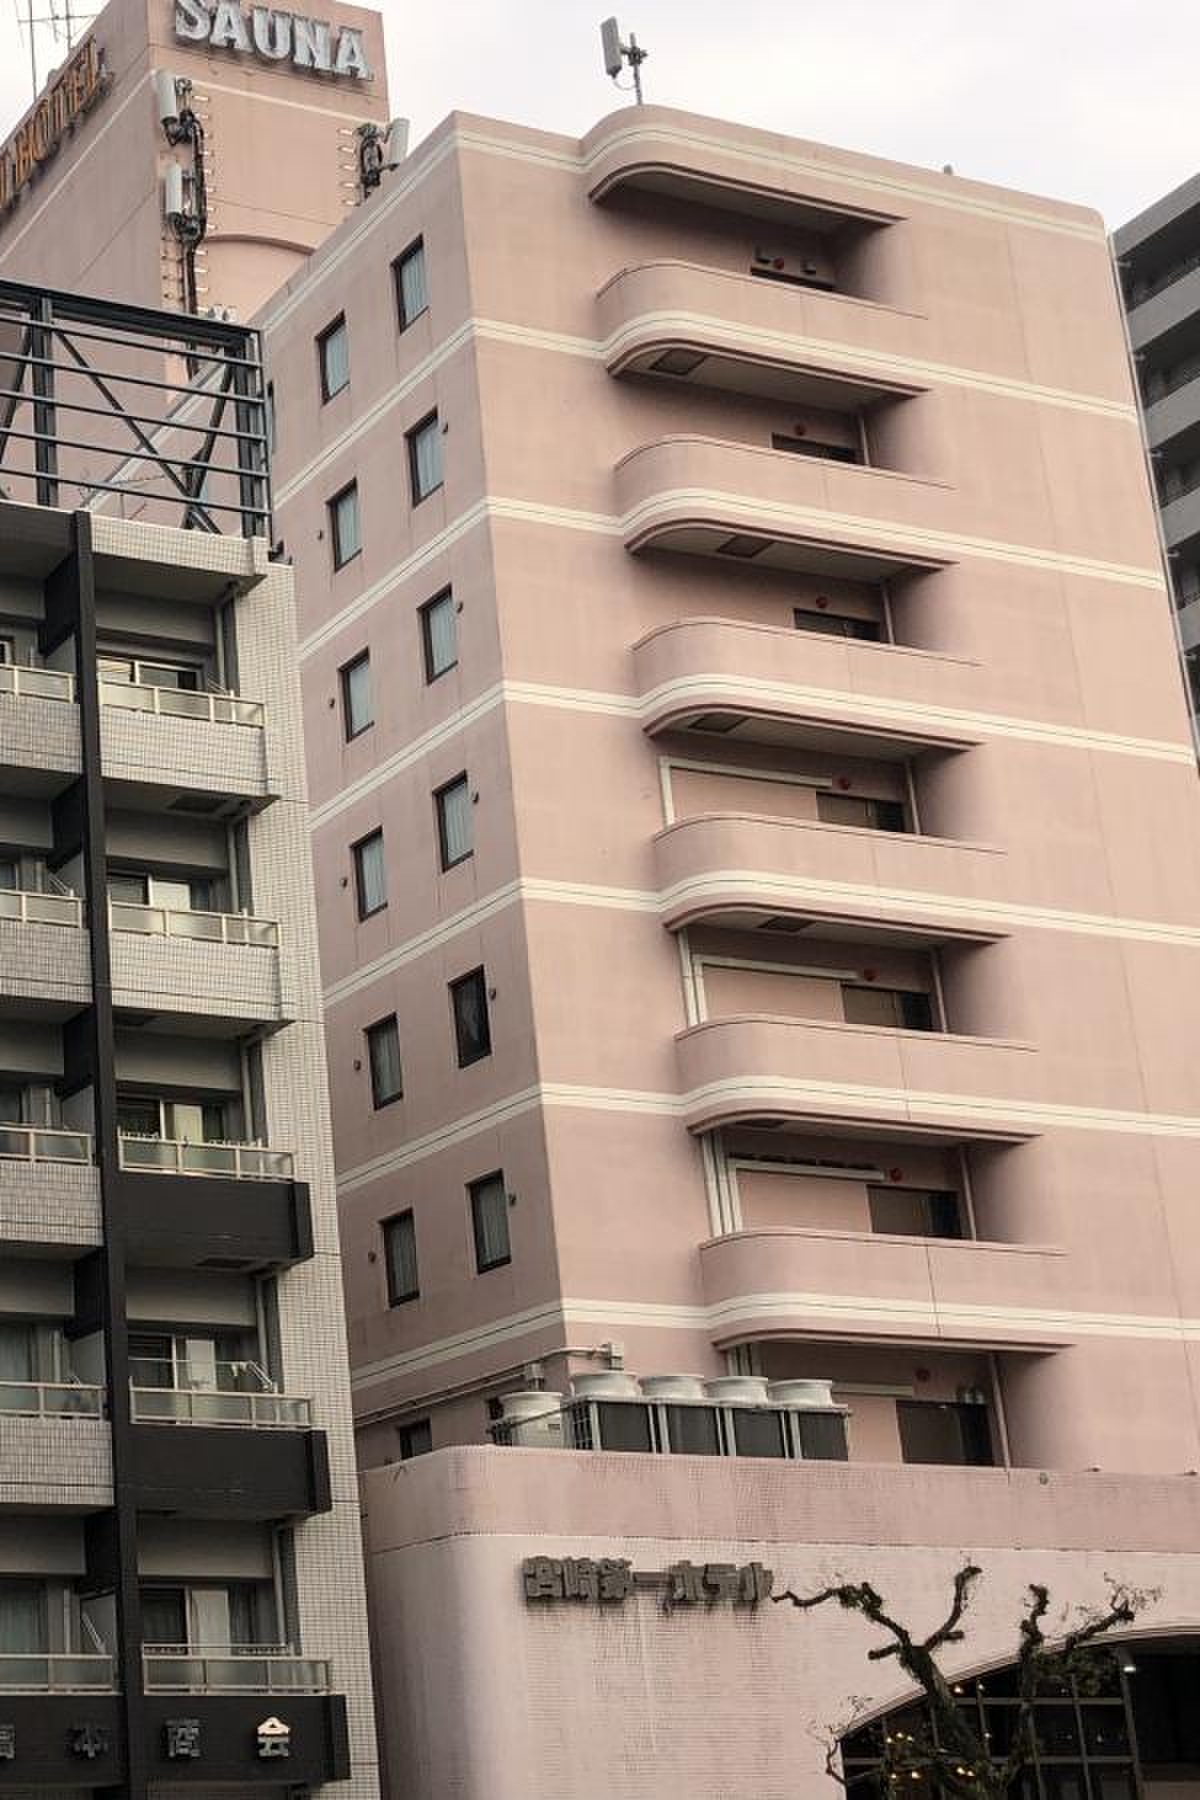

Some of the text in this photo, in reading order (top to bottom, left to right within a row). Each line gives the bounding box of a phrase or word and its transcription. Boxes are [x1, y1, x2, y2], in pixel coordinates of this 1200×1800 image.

[175, 0, 373, 81] SAUNA
[523, 1555, 775, 1602] 宮崎第一ホテル
